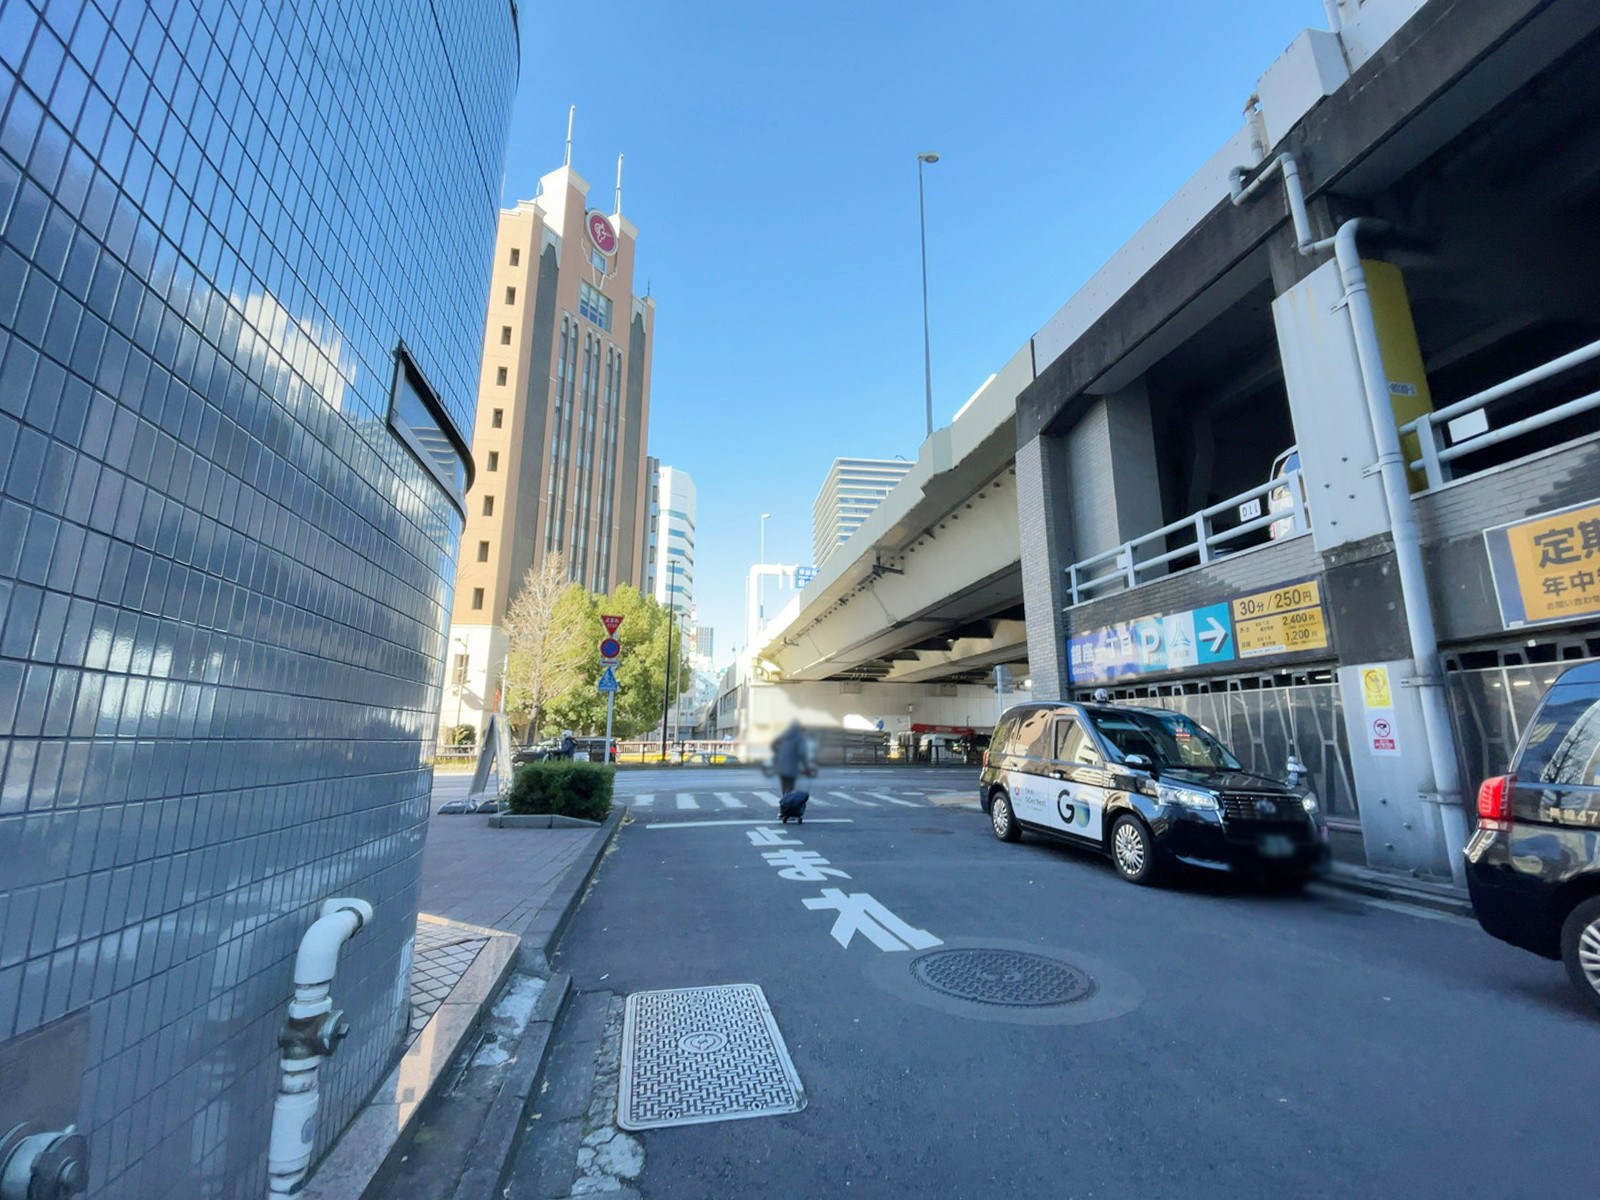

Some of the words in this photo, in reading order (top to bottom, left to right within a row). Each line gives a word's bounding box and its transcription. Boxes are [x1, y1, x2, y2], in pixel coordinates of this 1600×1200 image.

[1542, 568, 1600, 597] 年中
[745, 826, 944, 952] 止まれ
